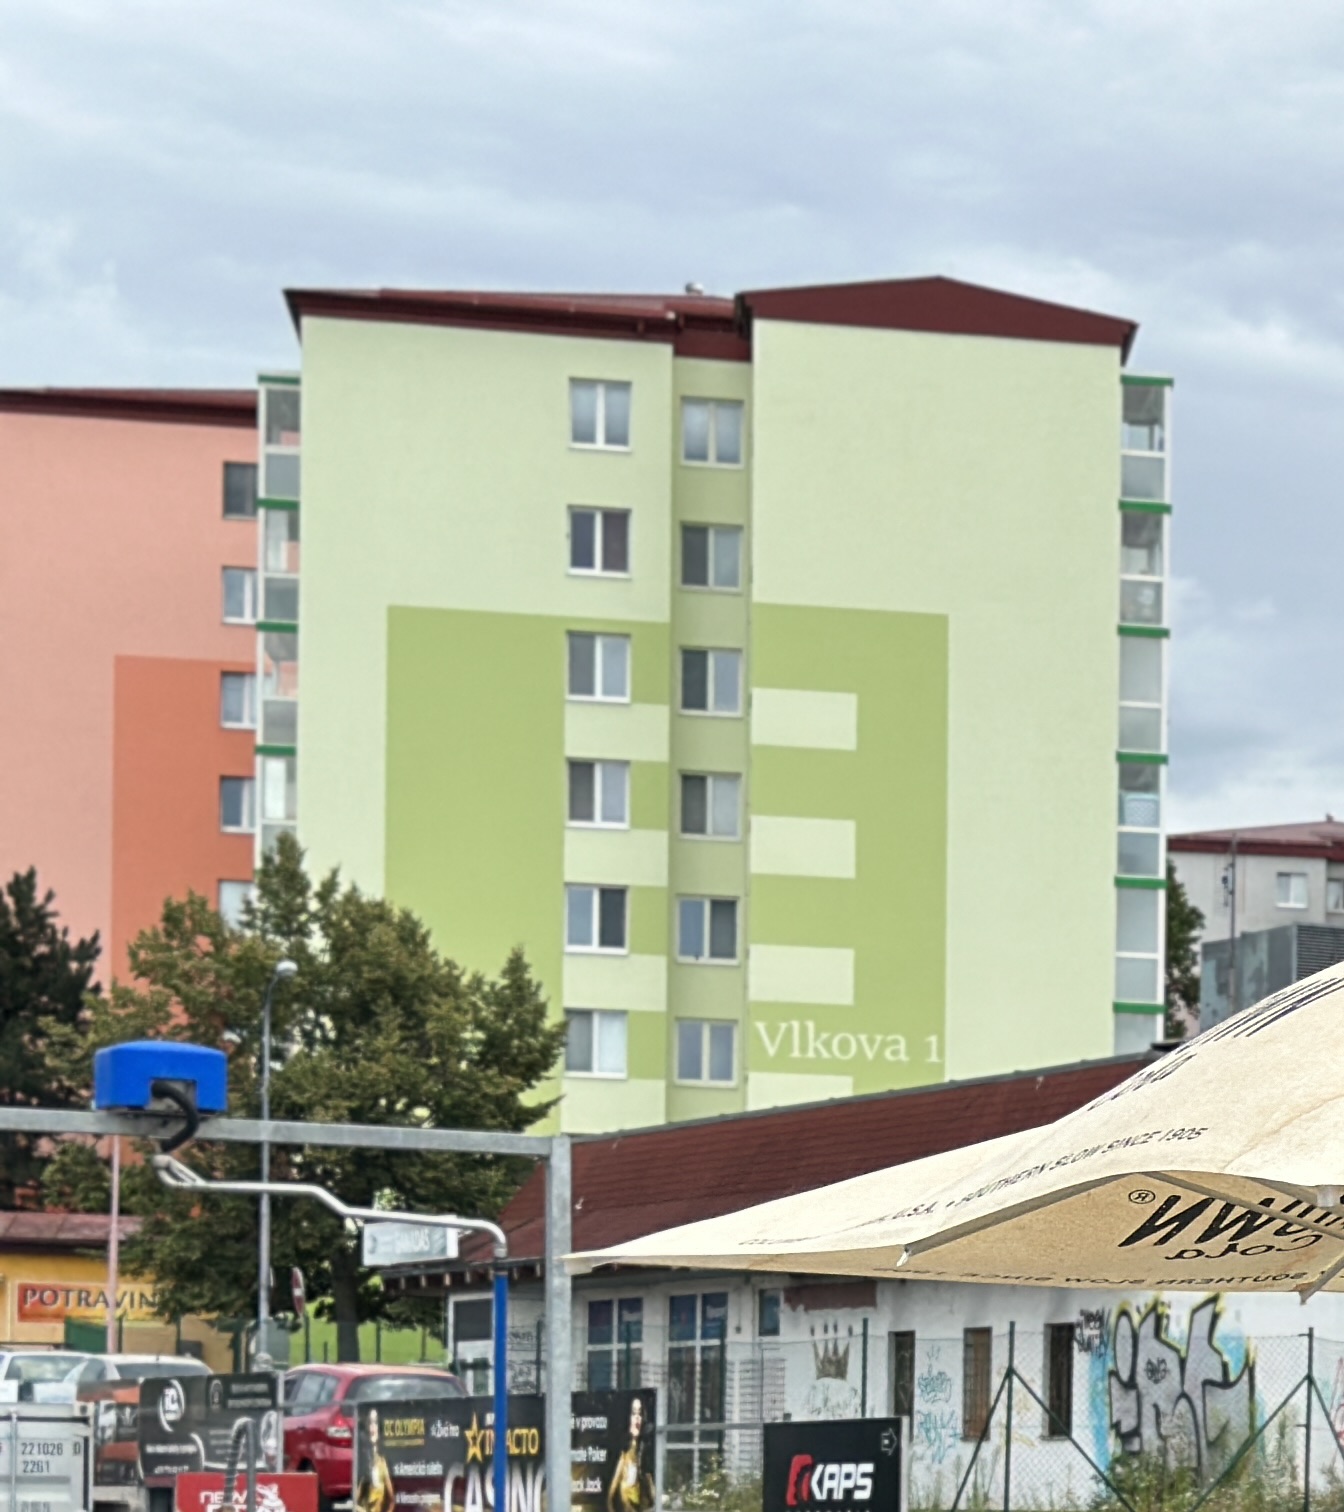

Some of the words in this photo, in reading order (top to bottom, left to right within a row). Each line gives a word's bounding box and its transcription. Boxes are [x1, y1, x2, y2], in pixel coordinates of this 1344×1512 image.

[754, 1020, 910, 1061] Vlkova
[925, 1034, 942, 1062] 1
[24, 1288, 159, 1309] POTRAVIN
[811, 1463, 874, 1500] KAPS
